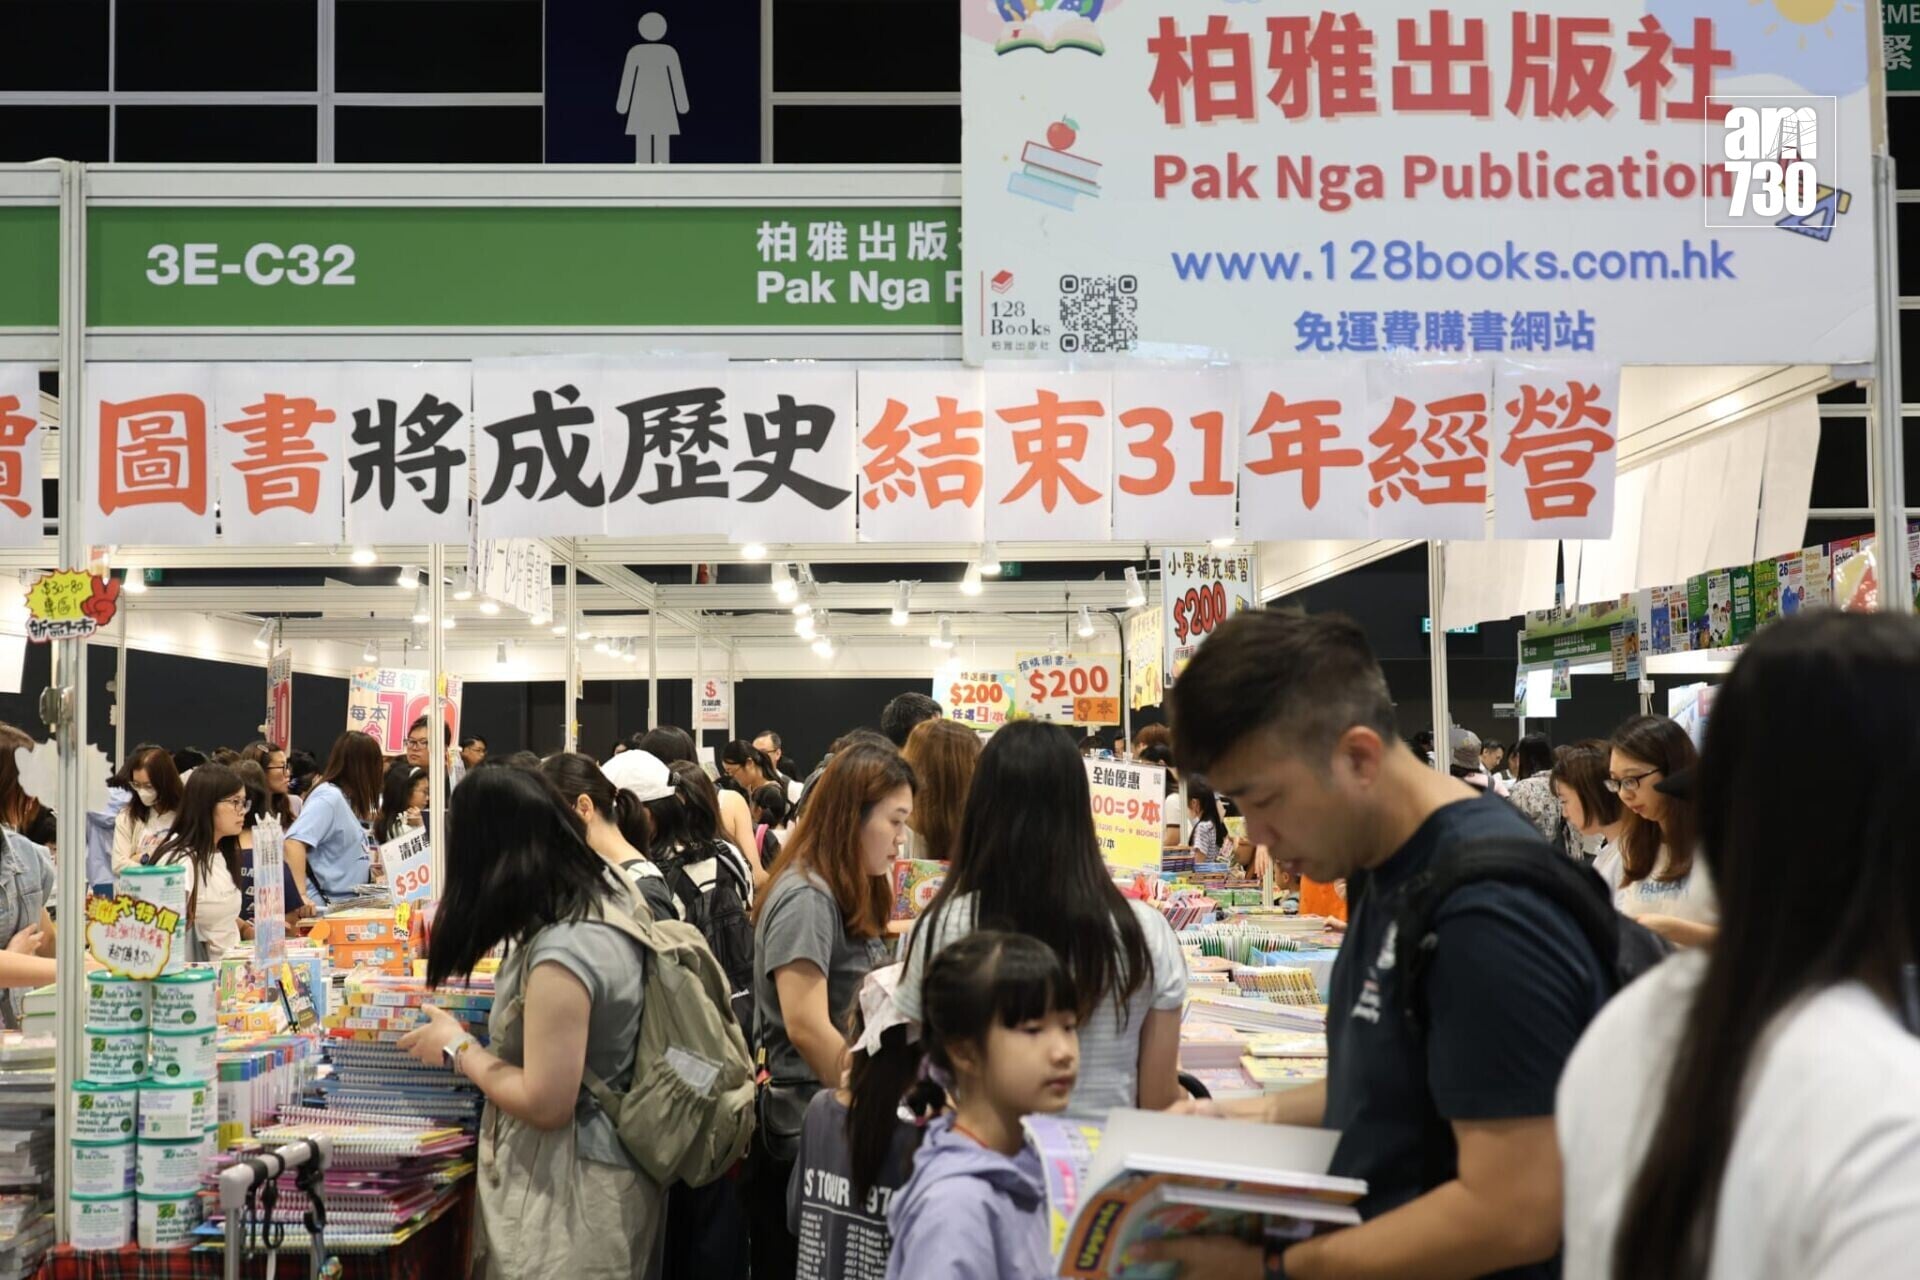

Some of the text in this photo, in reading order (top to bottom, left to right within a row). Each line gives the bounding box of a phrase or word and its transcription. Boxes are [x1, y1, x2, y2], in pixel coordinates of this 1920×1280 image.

[1147, 10, 1733, 125] 柏雅出版社
[1153, 152, 1259, 200] Pak
[1277, 154, 1384, 212] Nga
[756, 220, 962, 262] 柏雅出版
[1172, 239, 1737, 282] www.128books.com.hk
[146, 242, 356, 286] 3E-C32
[757, 270, 836, 304] Pak
[850, 270, 931, 310] Nga
[991, 301, 1026, 318] 128
[991, 319, 1050, 336] Books
[1294, 309, 1596, 352] 免運費購書網站
[1168, 551, 1249, 583] 小學補充練習
[1779, 562, 1789, 577] 26
[1174, 580, 1227, 646] $200
[951, 684, 1003, 706] $200
[1029, 665, 1109, 703] $200
[395, 864, 430, 897] $30
[818, 1169, 849, 1207] TOUR
